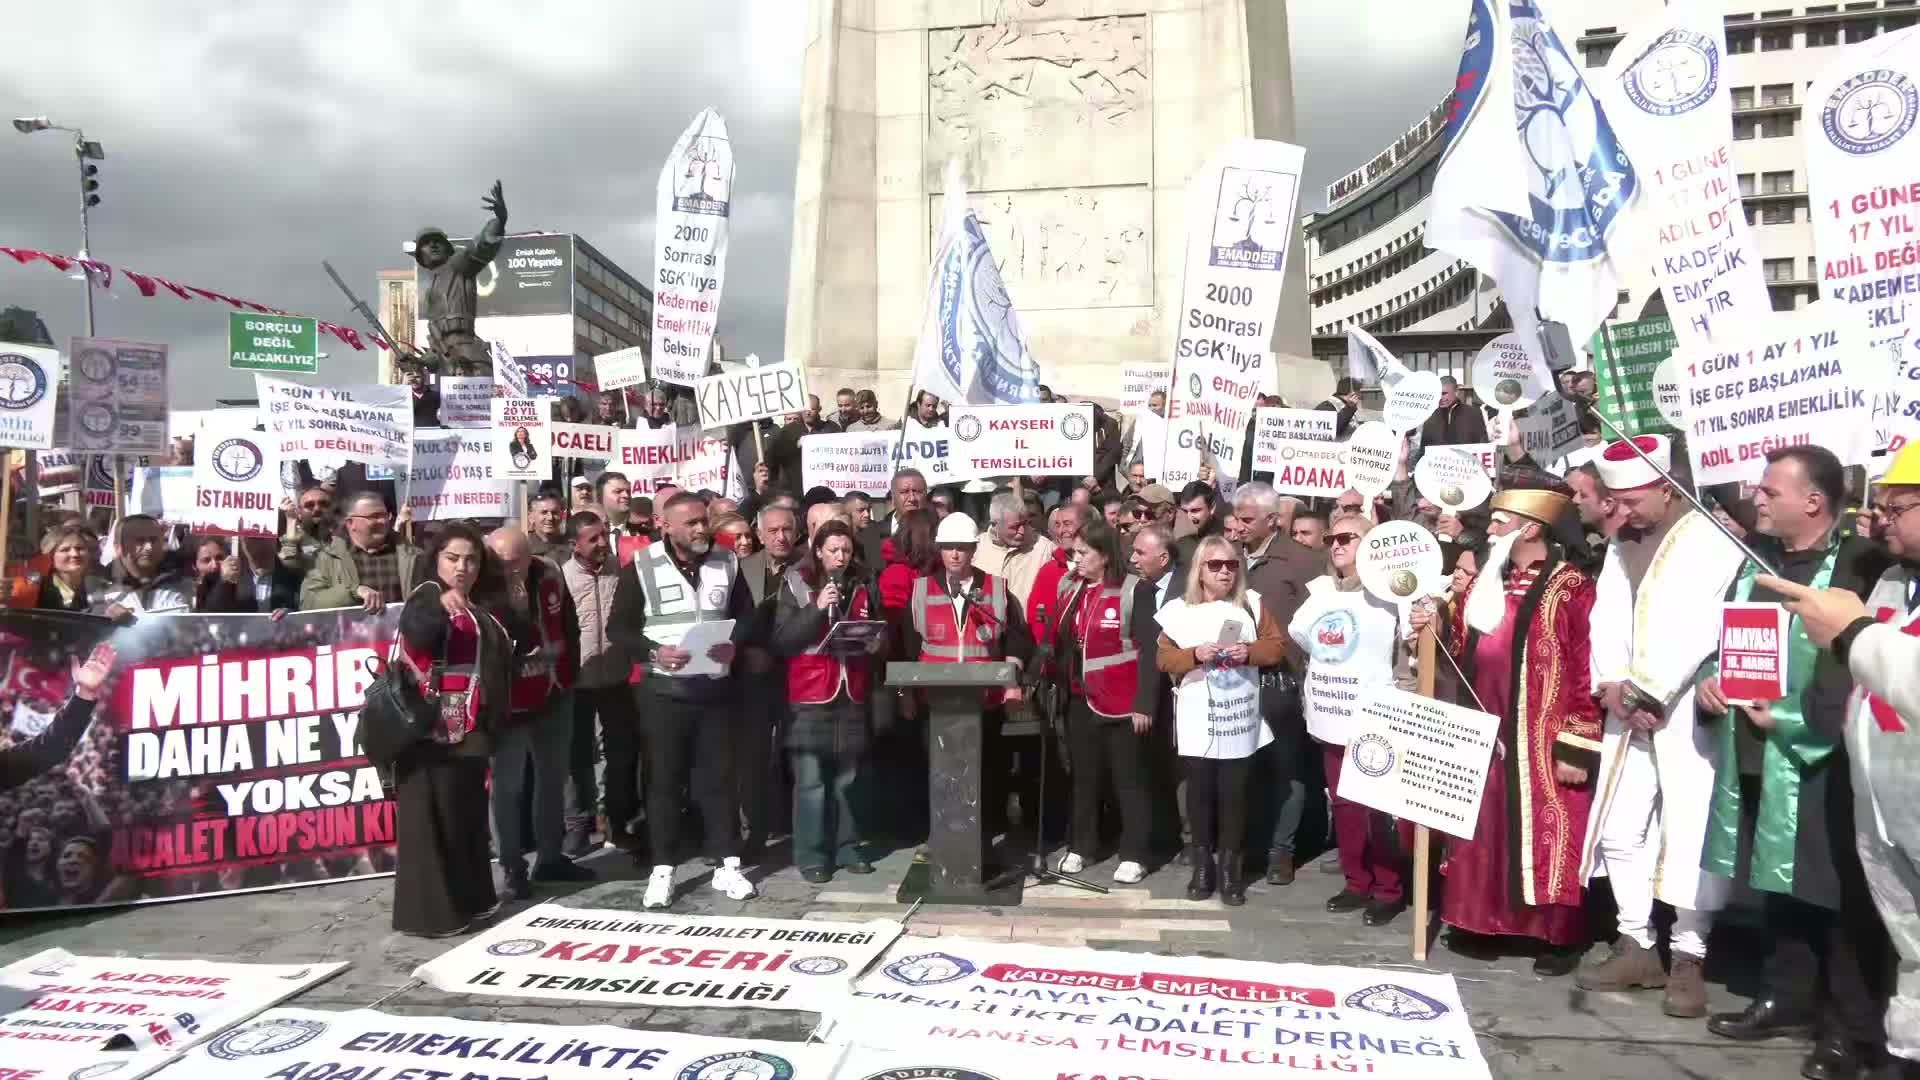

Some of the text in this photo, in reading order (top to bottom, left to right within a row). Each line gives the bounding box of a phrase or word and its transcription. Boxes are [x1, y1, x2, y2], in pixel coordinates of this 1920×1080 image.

[1829, 200, 1840, 219] 1
[674, 224, 709, 243] 2000
[1849, 215, 1914, 243] 17 YIL
[507, 257, 563, 269] 100 Yaşında
[664, 246, 717, 267] Sonrası
[1217, 247, 1276, 265] EMADDER
[1824, 252, 1869, 280] ADİL
[1206, 283, 1253, 306] 2000
[245, 320, 303, 335] BORÇLU
[1188, 308, 1263, 338] Sonrası
[253, 335, 295, 348] DEĞİL
[663, 338, 701, 358] Gelsin
[232, 351, 314, 366] ALACAKLIYIZ
[1178, 338, 1262, 373] SGK'lıya
[1688, 329, 1840, 379] 1 GÜN 1 AY 1 YIL
[1690, 358, 1843, 408] İŞE GEÇ BAŞLAYANA
[331, 390, 353, 401] YIL
[512, 399, 536, 408] GÜNE
[1394, 391, 1435, 401] HAKKIMIZI
[503, 407, 538, 416] 20 YIL
[1186, 401, 1212, 417] ADANA
[1693, 389, 1866, 438] 17 YIL SONRA EMEKLİLİK
[308, 419, 348, 432] SONRA
[988, 418, 1055, 431] KAYSERİ
[1294, 420, 1306, 428] AY
[1316, 420, 1333, 430] YIL
[462, 441, 480, 455] YAŞ
[1015, 437, 1029, 450] İL
[1351, 444, 1392, 460] HAKKIMIZI
[970, 453, 1073, 470] TEMSİLCİLİĞİ
[1700, 446, 1735, 470] ADİL
[464, 465, 483, 480] YAŞ
[1280, 465, 1346, 489] ADANA
[196, 485, 275, 511] İSTANBUL
[454, 491, 501, 506] NEREDE
[1370, 531, 1420, 550] ORTAK
[1724, 627, 1778, 651] ANAYASA
[126, 722, 255, 782] DAHA
[264, 712, 322, 768] NE
[216, 765, 386, 817] YOKSA
[235, 805, 357, 859] KOPSUN
[526, 915, 877, 947] EMEKLİLİKTE ADALET DERNEĞİ
[538, 940, 796, 974] KAYSERİ
[91, 971, 231, 987] KADEME
[466, 966, 793, 1003] İL TEMSİLCİLİĞİ
[1151, 979, 1312, 1005] EMEKLİLİK
[8, 1018, 129, 1032] EMADDER
[927, 1025, 1079, 1051] MANİSA
[1109, 1012, 1261, 1039] ADALET
[1275, 1027, 1467, 1061] DERNEĞİ
[340, 1030, 669, 1072] EMEKLİLİKTE
